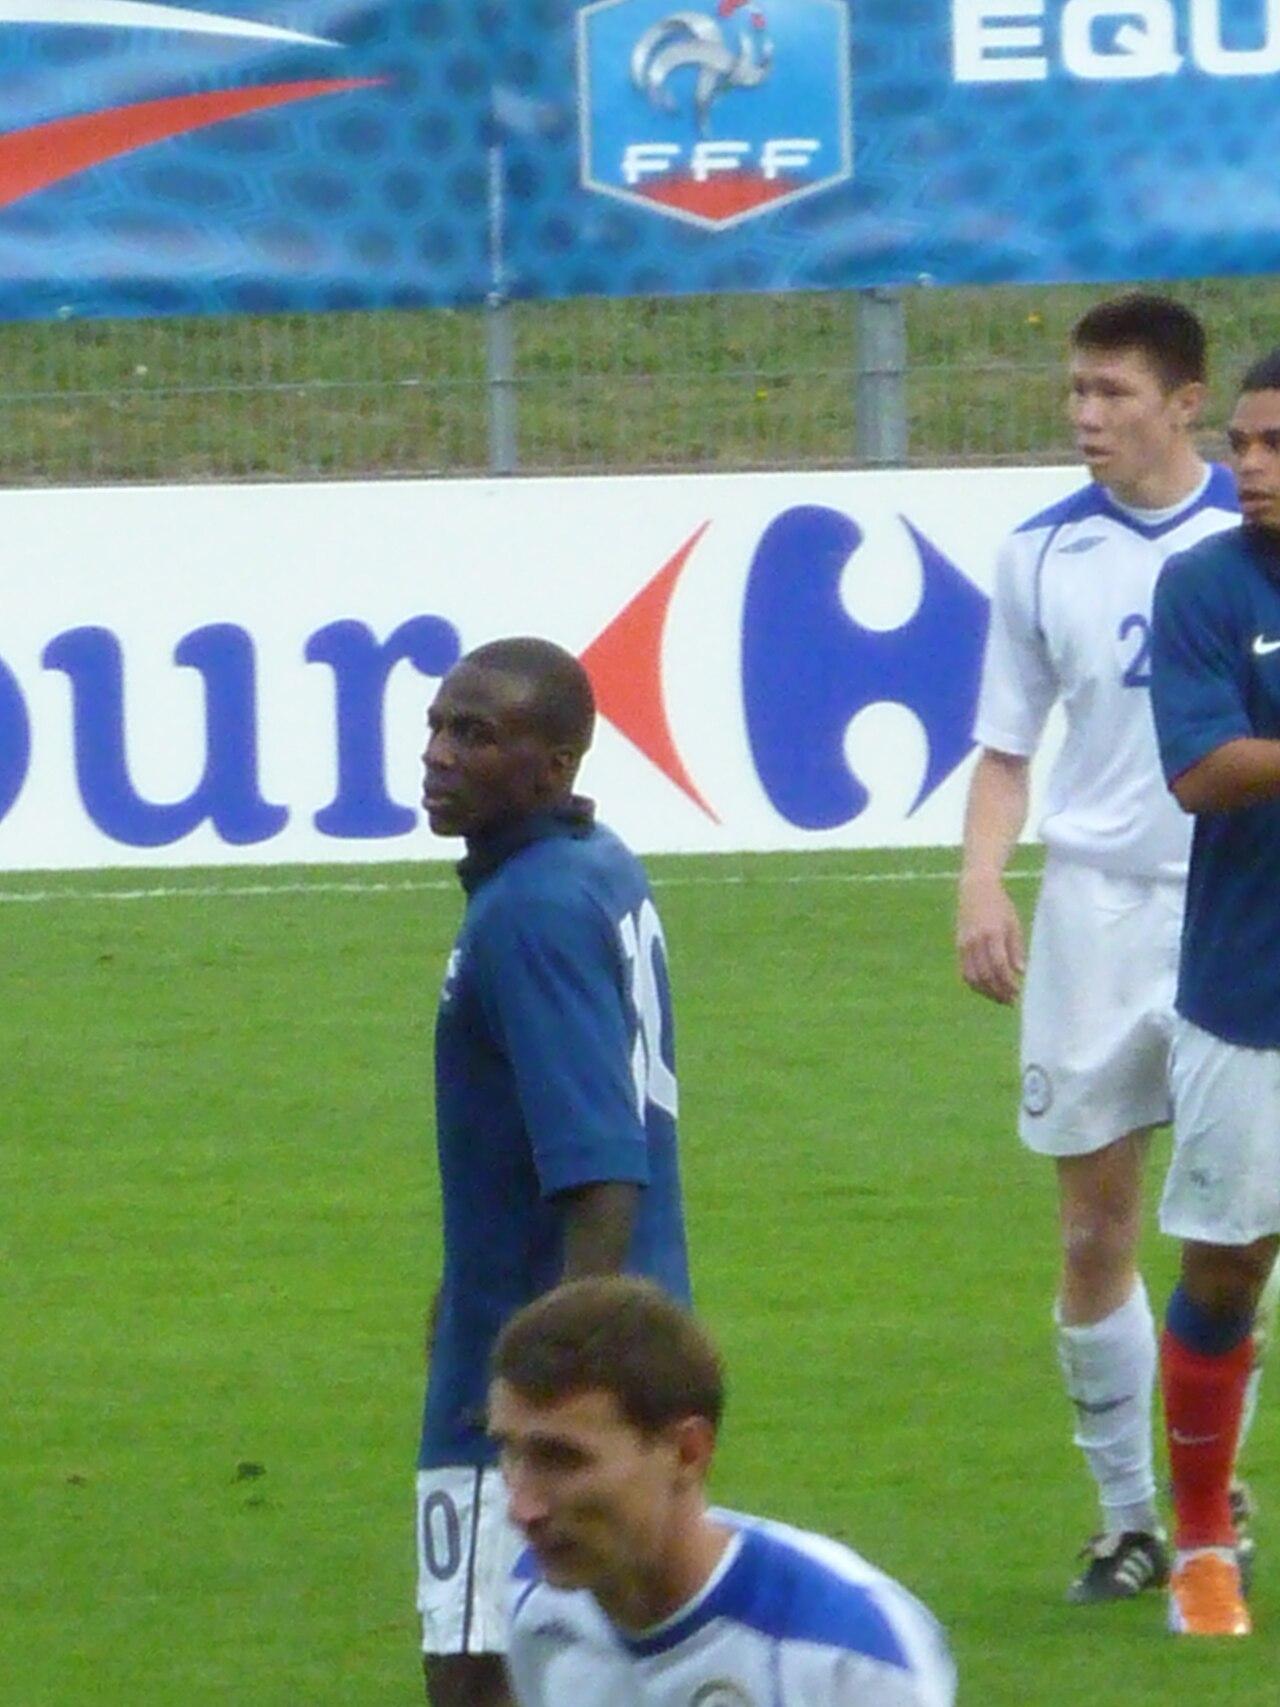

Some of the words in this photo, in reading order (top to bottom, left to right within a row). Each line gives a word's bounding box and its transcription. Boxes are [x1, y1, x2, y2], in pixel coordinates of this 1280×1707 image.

[952, 0, 1280, 82] EQU
[621, 139, 819, 184] FFF
[1118, 613, 1152, 687] 2
[0, 614, 462, 848] ur
[424, 1490, 460, 1581] 0
